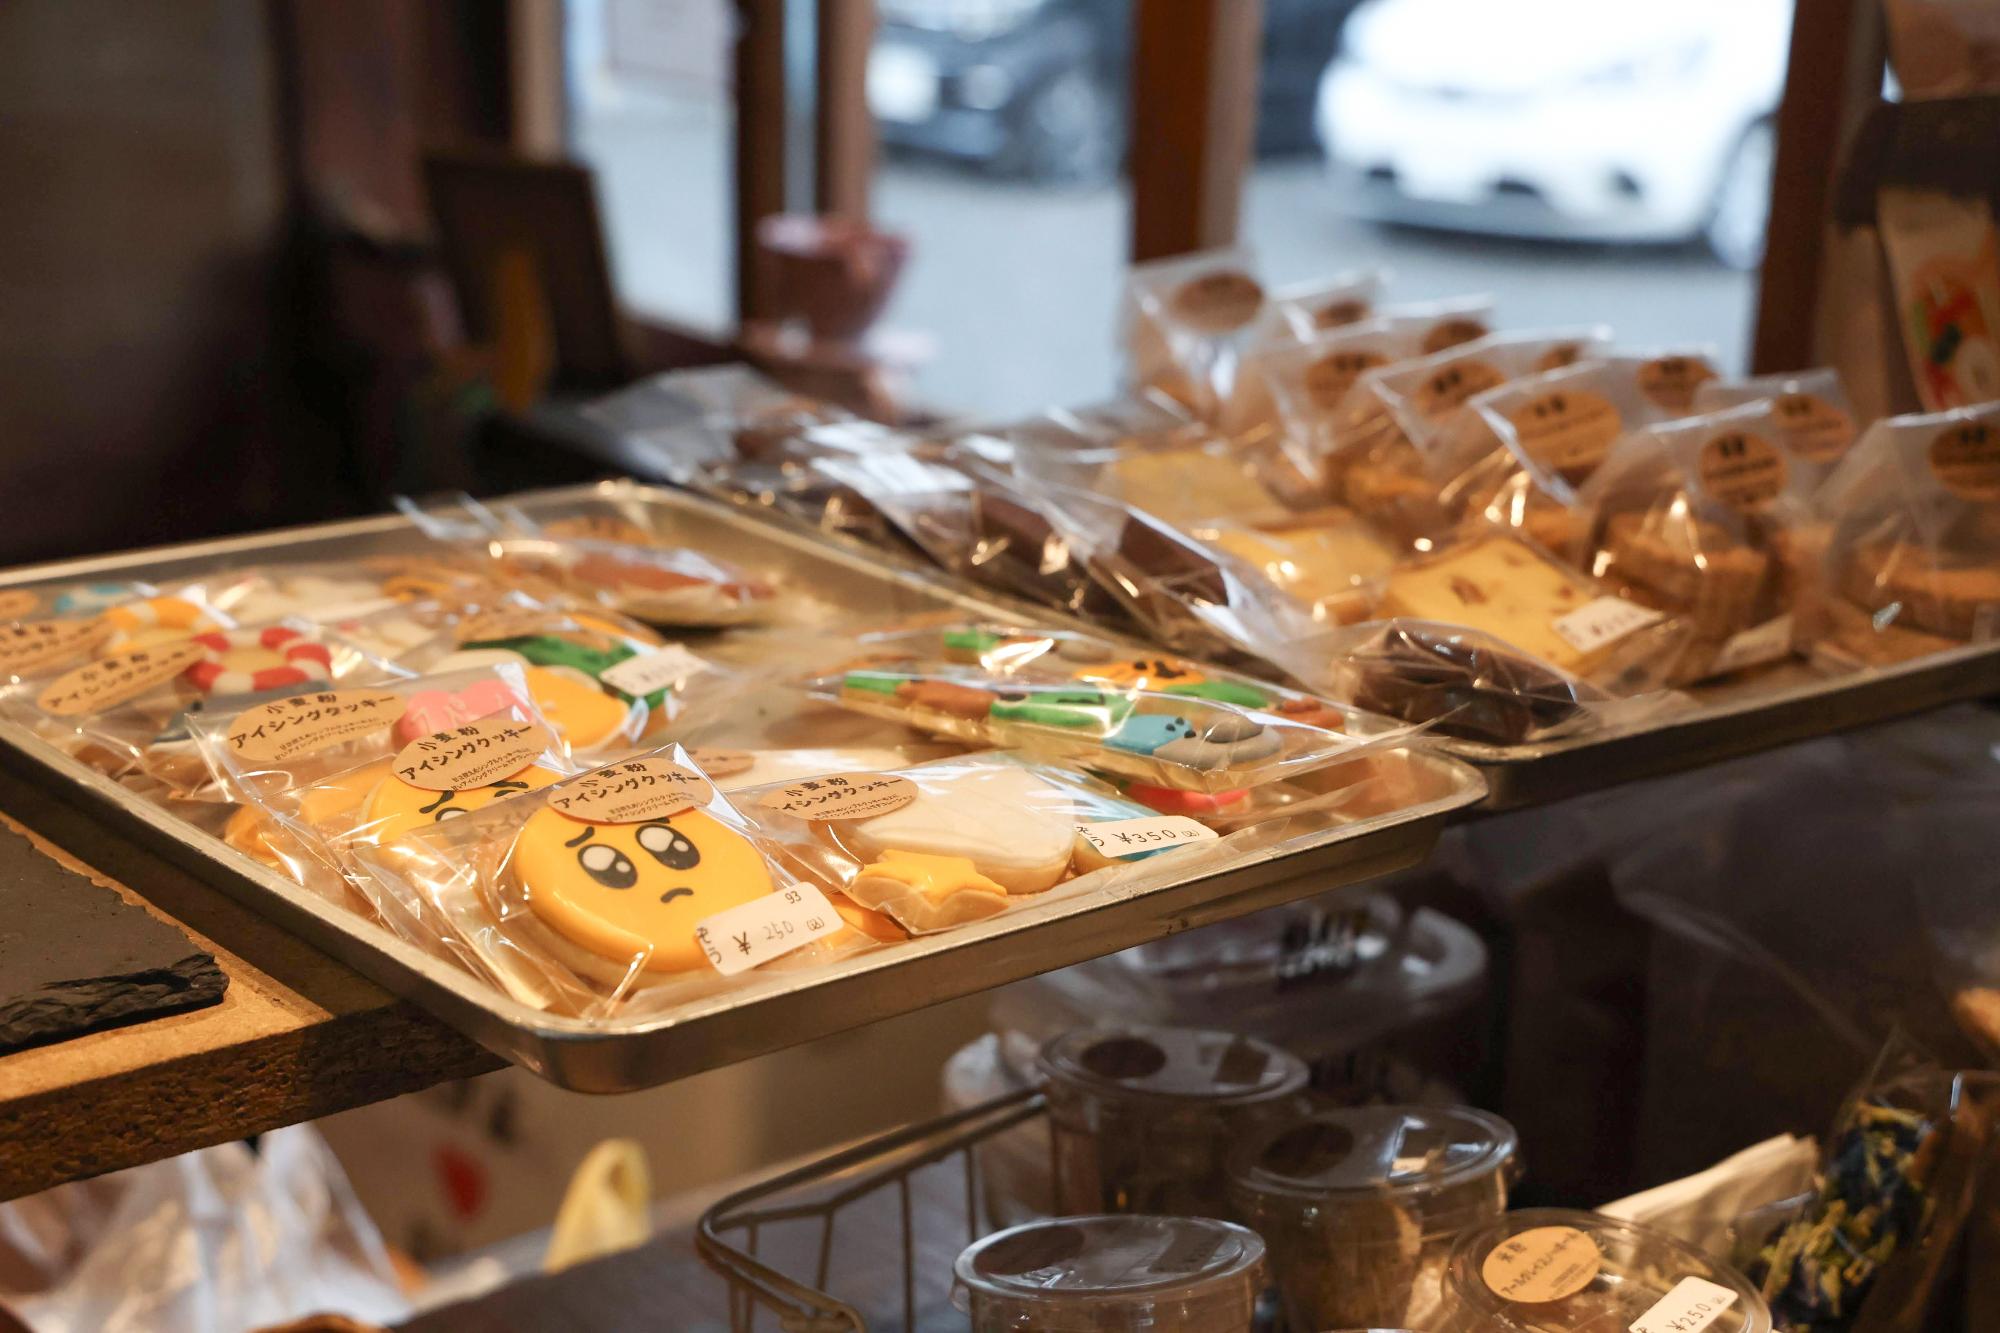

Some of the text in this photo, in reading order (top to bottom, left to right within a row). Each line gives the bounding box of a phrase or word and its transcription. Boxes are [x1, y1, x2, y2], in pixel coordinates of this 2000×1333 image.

[229, 696, 396, 749] アイシングクッキー
[417, 726, 480, 751] 小麦粉
[399, 725, 533, 780] アイシングクッキー
[579, 763, 648, 788] 小麦粉
[785, 777, 849, 797] 小麦粉
[554, 771, 701, 809] アイシングクッキー
[771, 778, 904, 811] イシングクッキー
[1111, 829, 1177, 845] ¥350
[784, 890, 802, 904] 93
[1665, 1303, 1712, 1331] ¥250
